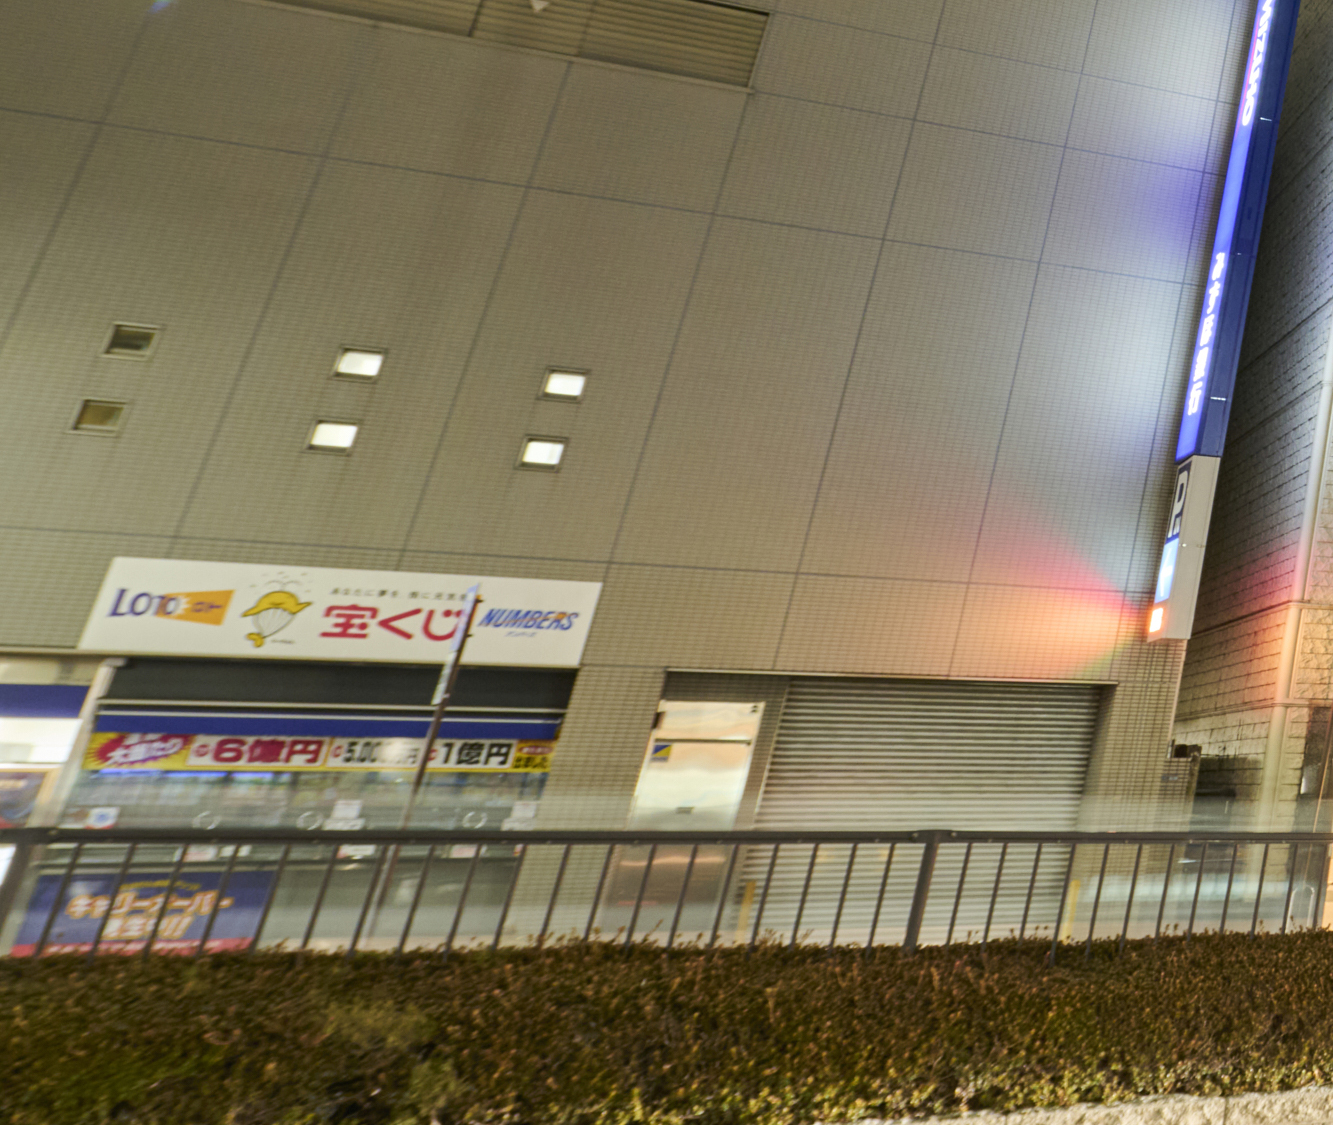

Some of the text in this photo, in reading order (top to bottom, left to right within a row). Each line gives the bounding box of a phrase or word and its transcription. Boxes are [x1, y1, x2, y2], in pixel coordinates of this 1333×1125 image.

[319, 604, 467, 642] 宝くじ
[477, 608, 581, 632] NUMBERS
